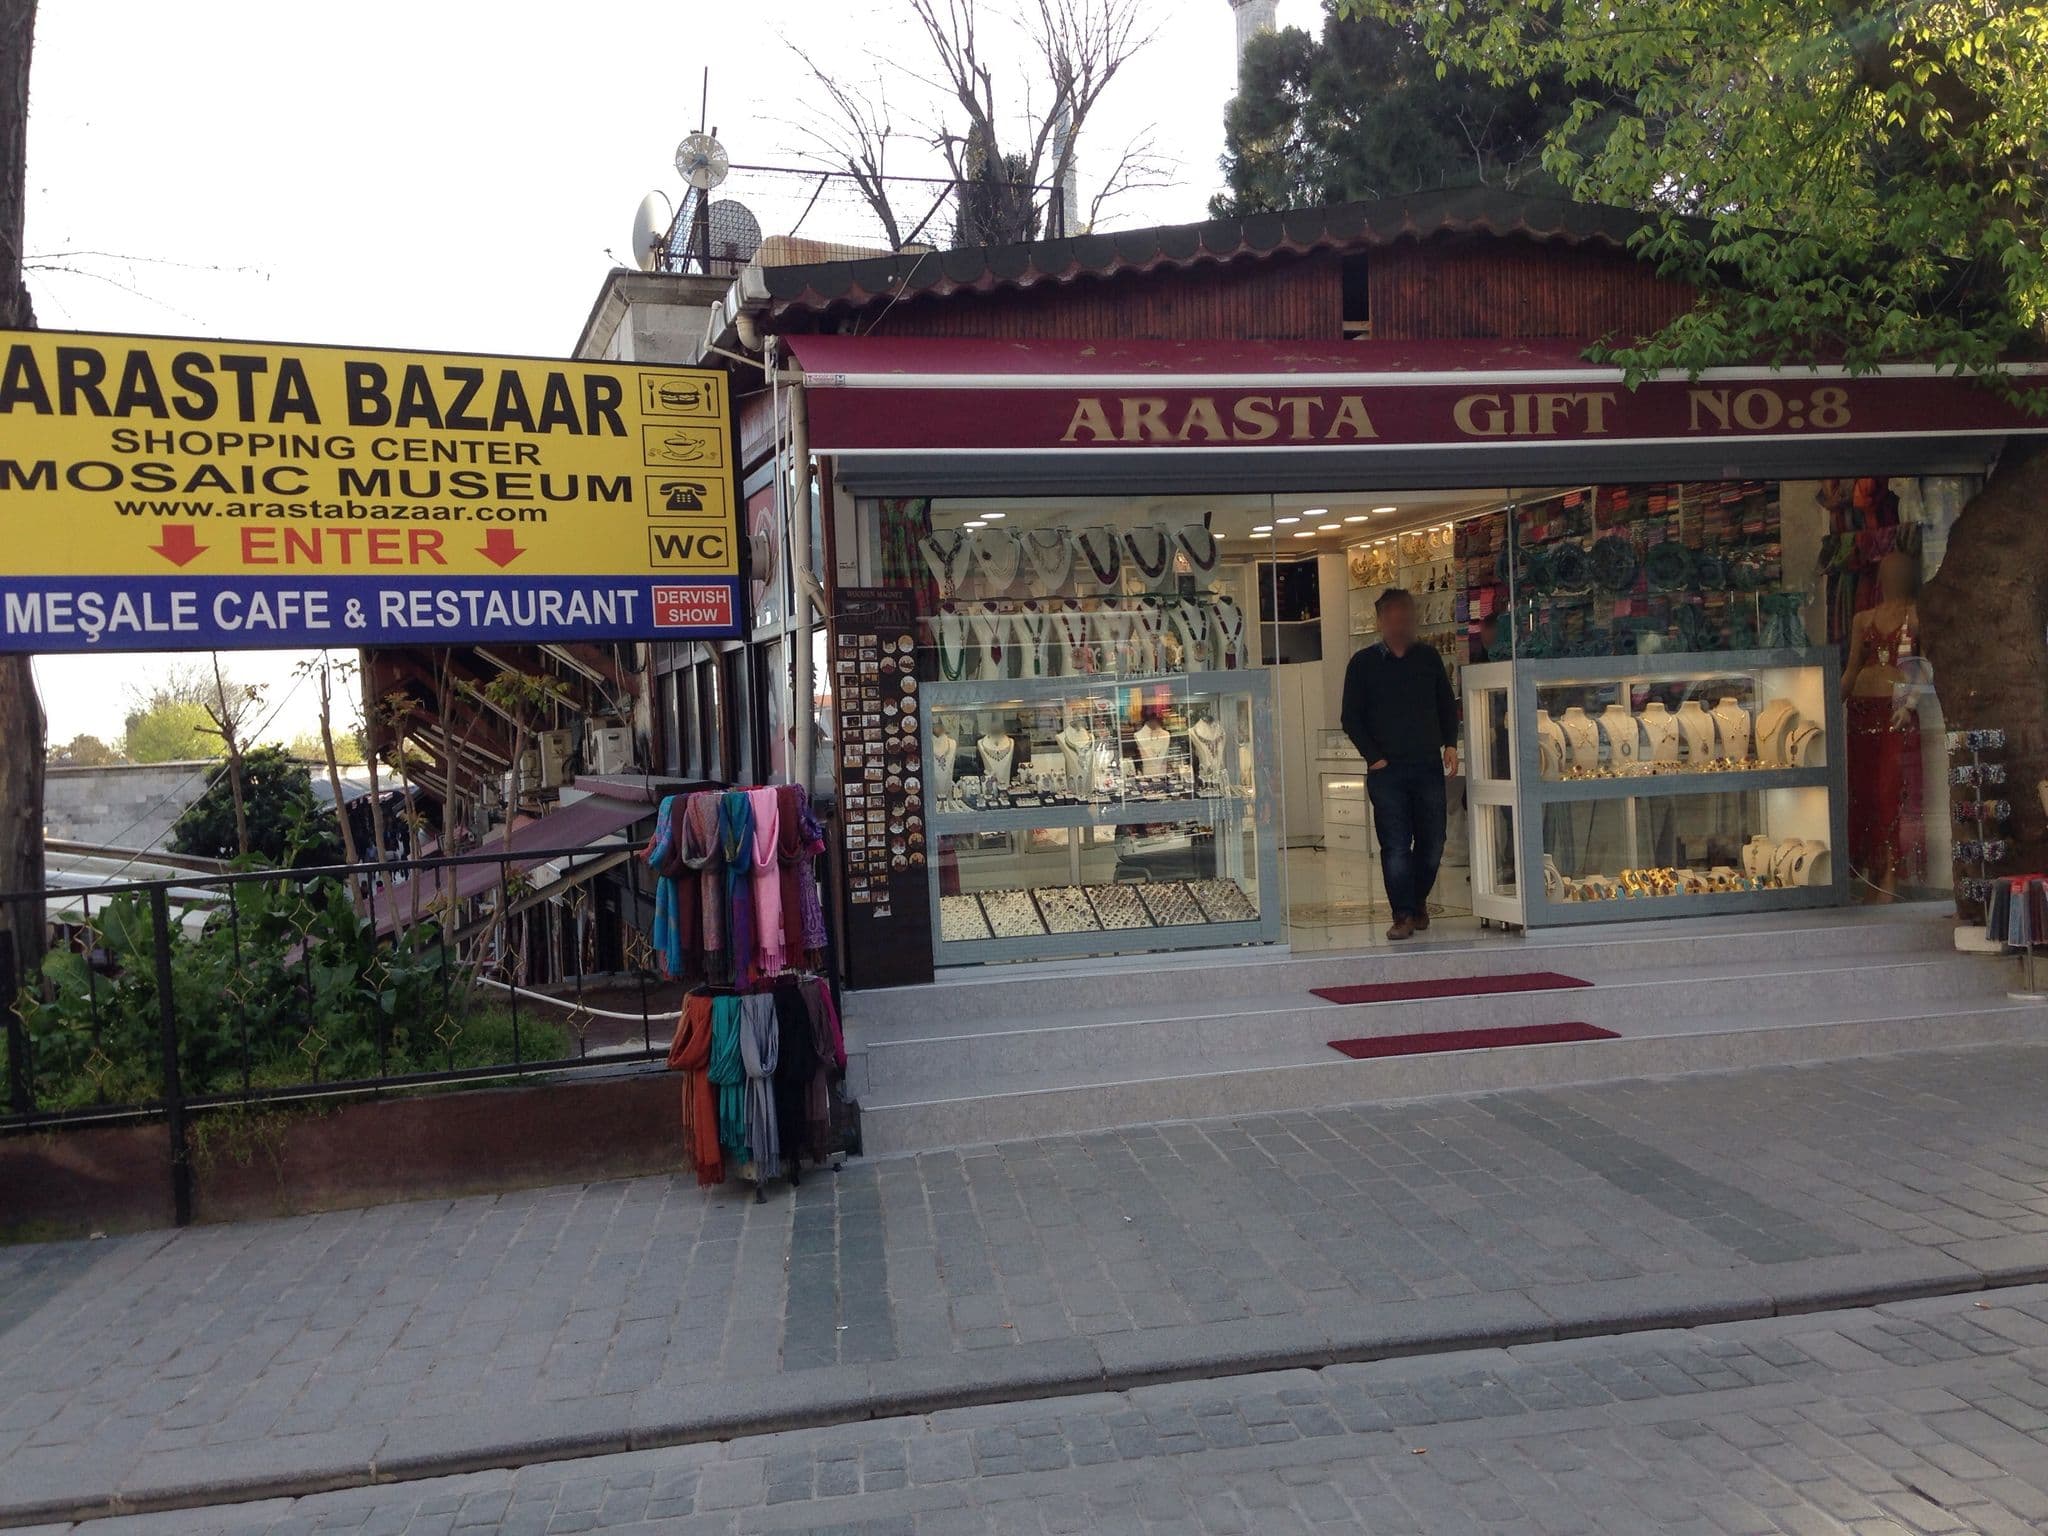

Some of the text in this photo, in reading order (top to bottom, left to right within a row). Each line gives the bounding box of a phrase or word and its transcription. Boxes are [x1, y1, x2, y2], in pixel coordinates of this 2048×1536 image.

[0, 344, 628, 437] ARASTA BAZAAR
[1060, 387, 1851, 442] ARASTA GIFT NO:8
[111, 428, 542, 465] SHOPPING CENTER
[0, 460, 634, 502] MOSAIC MUSEUM
[115, 499, 547, 522] www.arastabazaar.com
[240, 527, 448, 565] ENTER
[655, 534, 723, 559] WC
[657, 590, 727, 605] DERVISH
[668, 608, 718, 622] SHOW
[5, 590, 638, 643] MEŞALE CAFE & RESTAURANT
